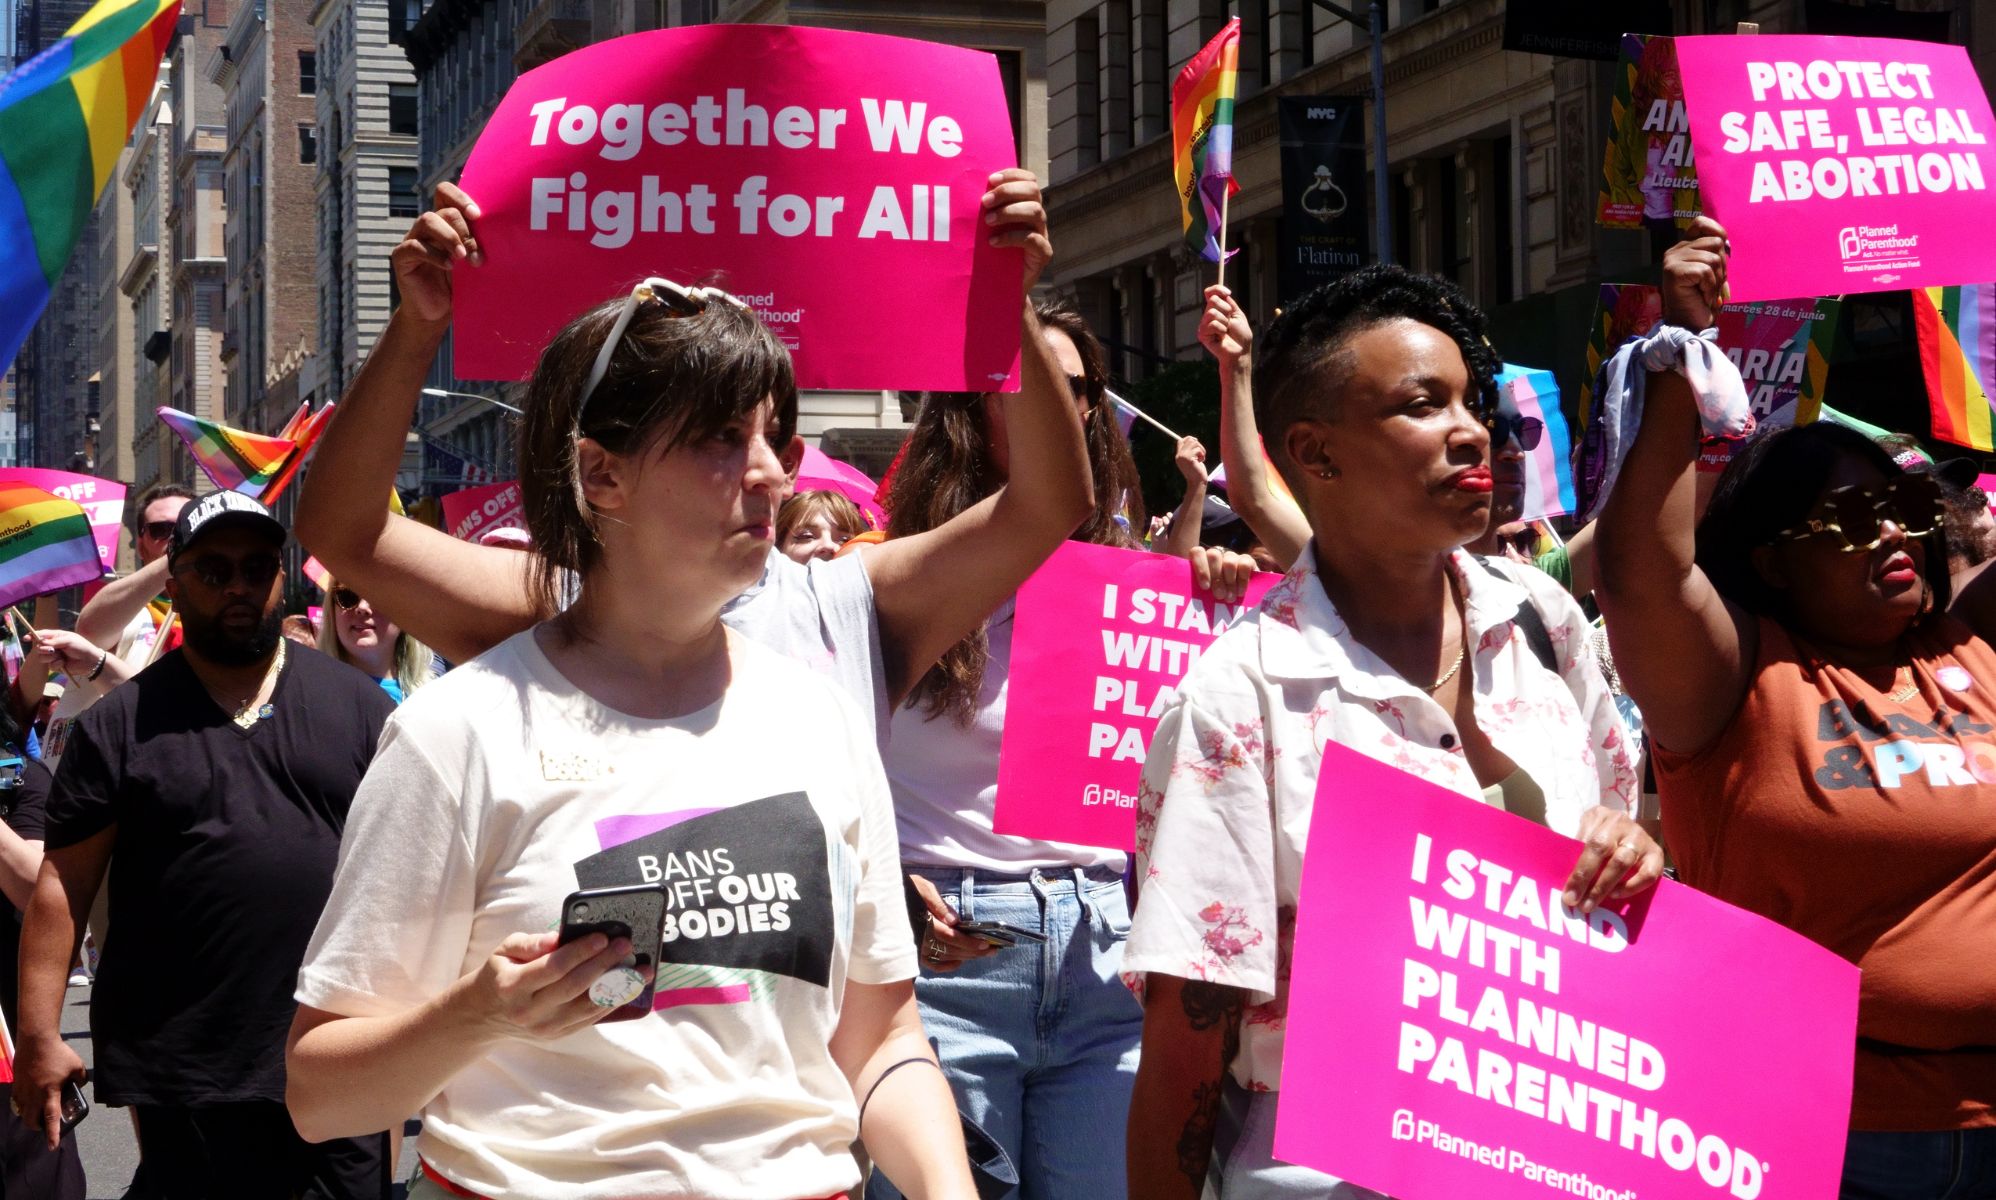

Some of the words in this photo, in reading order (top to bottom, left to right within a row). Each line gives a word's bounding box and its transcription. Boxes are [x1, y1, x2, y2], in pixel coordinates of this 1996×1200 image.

[1747, 60, 1934, 101] PROTECT
[530, 88, 847, 161] Together
[860, 98, 963, 158] We
[1307, 107, 1336, 120] NYC
[1642, 99, 1690, 132] AN
[1720, 109, 1848, 154] SAFE,
[1856, 106, 1987, 145] LEGAL
[1651, 172, 1699, 189] Lieute
[1749, 152, 1986, 203] ABORTION
[530, 172, 717, 249] Fight
[733, 175, 844, 237] for
[858, 184, 951, 242] All
[1858, 224, 1897, 237] Planned
[1297, 246, 1360, 265] Flatiron
[1861, 236, 1917, 249] Parenthood
[733, 292, 774, 306] nned
[1722, 304, 1762, 314] martes
[1764, 305, 1780, 316] 28
[1782, 307, 1796, 318] de
[1797, 308, 1826, 321] junio
[1720, 338, 1806, 384] ARÍA
[0, 520, 31, 537] nthood
[187, 492, 225, 532] BLACK
[453, 510, 482, 540] ANS
[483, 486, 516, 516] OFF
[1103, 583, 1118, 619] I
[1128, 588, 1254, 636] STAN
[1817, 698, 1994, 742] BLACK
[1815, 739, 1996, 790] &PRO
[638, 848, 735, 883] BANS
[718, 873, 801, 904] OUR
[1410, 833, 1433, 884] I
[1442, 849, 1628, 953] STAND
[661, 902, 791, 943] BODIES
[1409, 896, 1560, 994] WITH
[1402, 958, 1666, 1092] PLANNED
[1417, 1119, 1506, 1169] Planned
